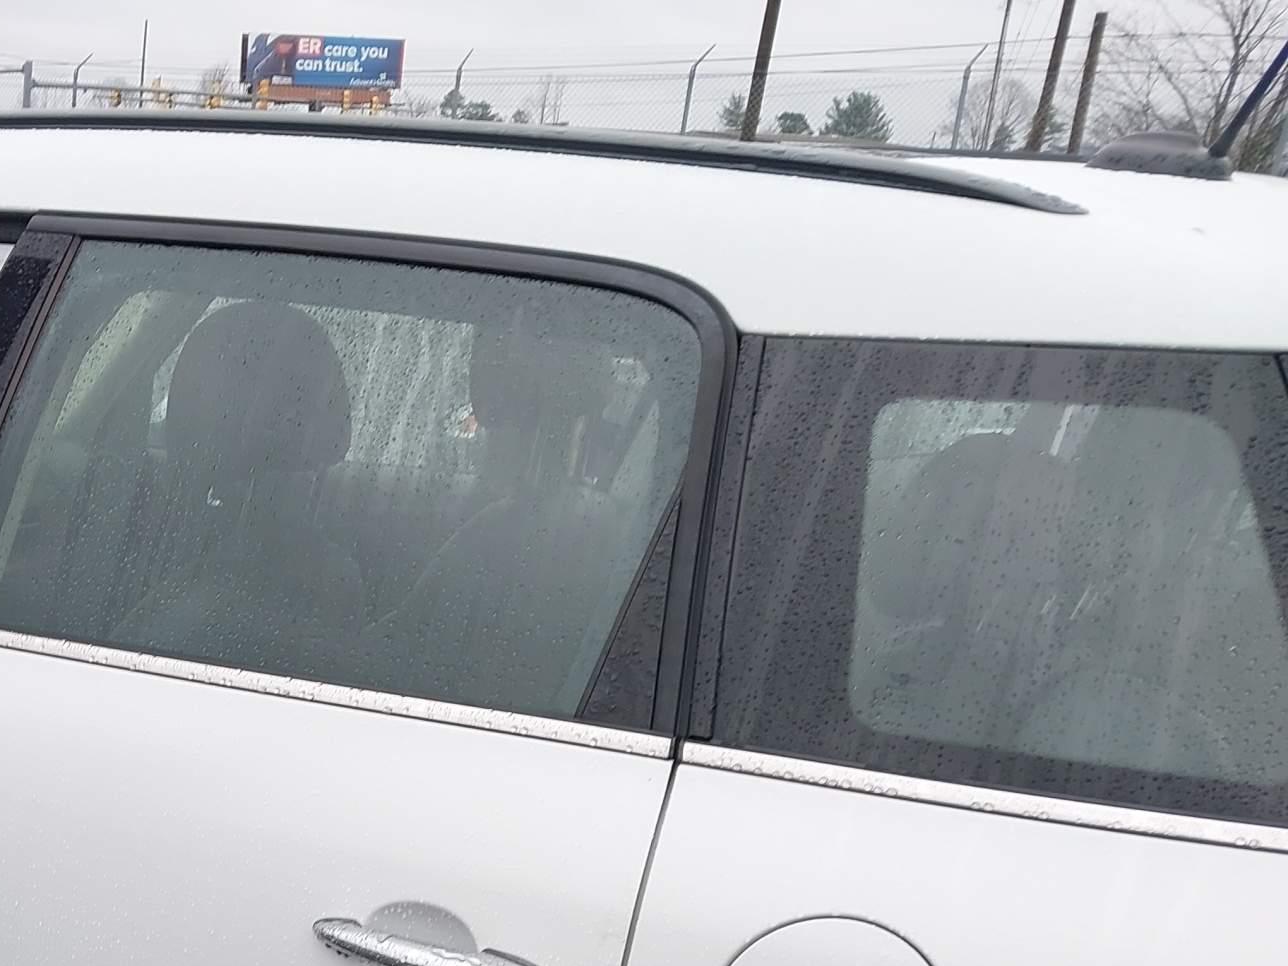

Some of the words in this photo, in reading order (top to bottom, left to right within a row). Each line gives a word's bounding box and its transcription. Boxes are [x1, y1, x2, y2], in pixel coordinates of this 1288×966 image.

[297, 37, 322, 54] ER
[324, 44, 357, 57] care
[361, 45, 388, 61] you
[296, 58, 322, 71] can
[324, 59, 363, 73] trust.
